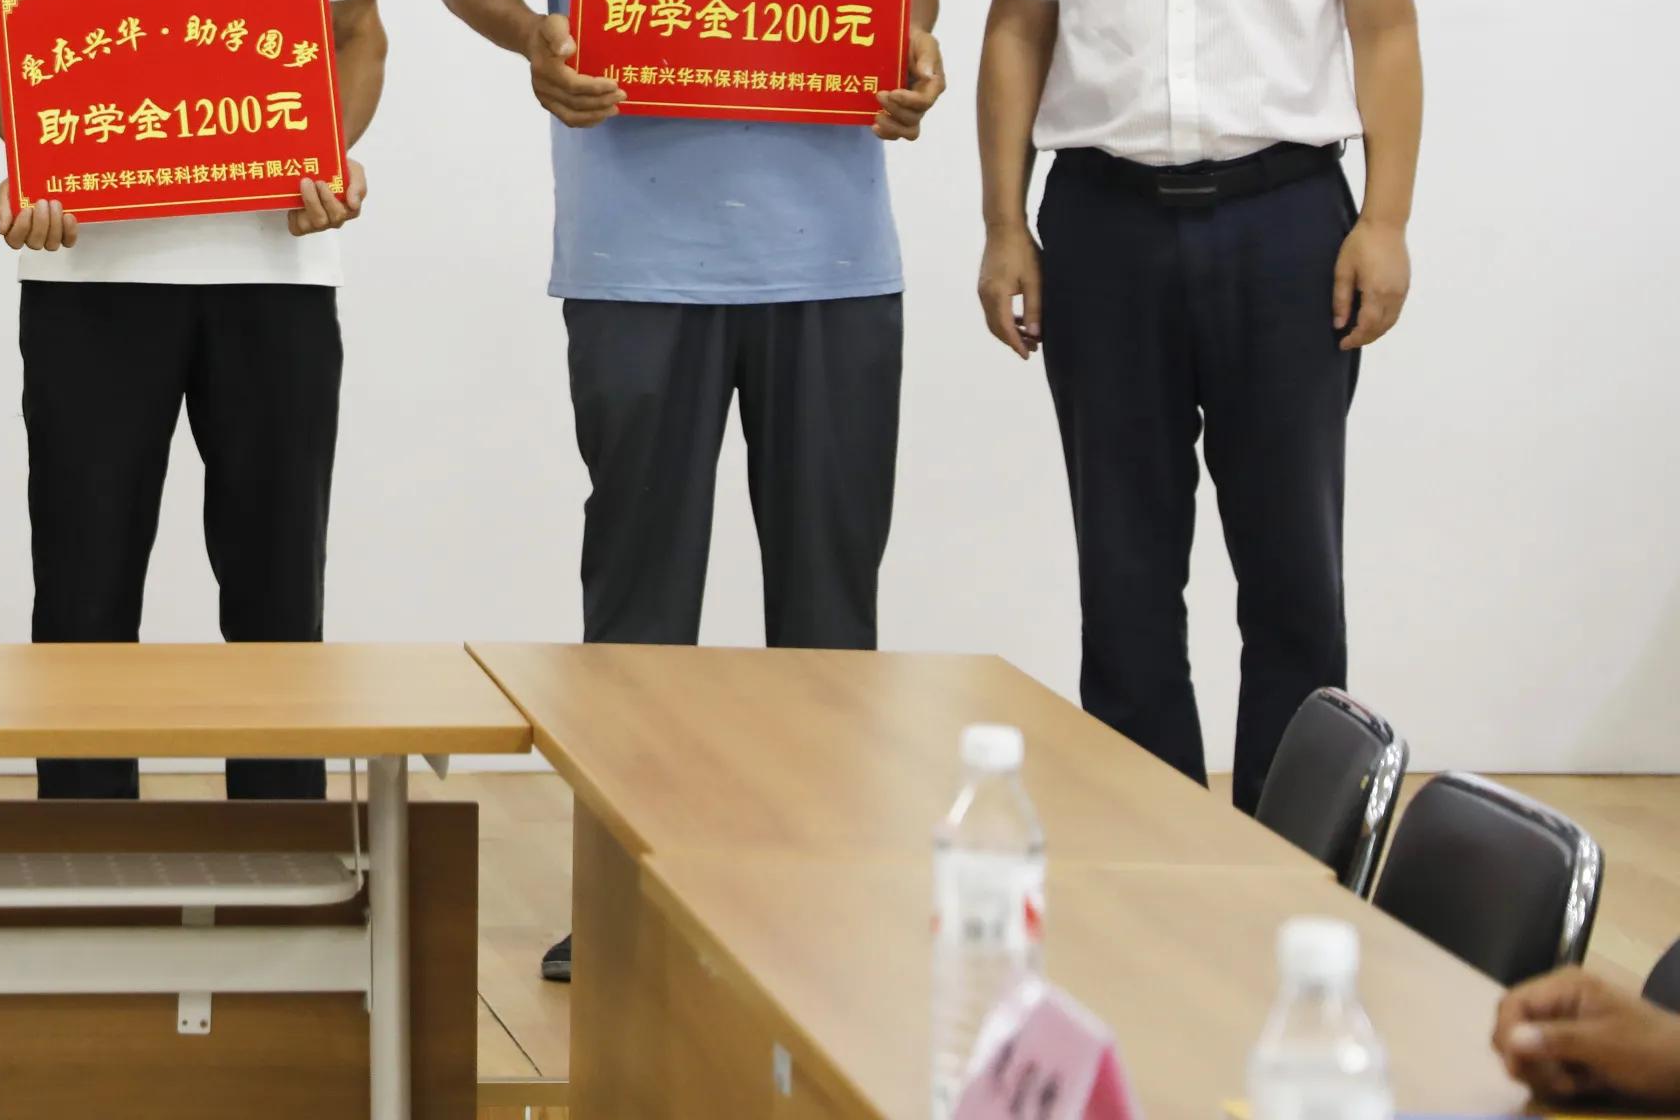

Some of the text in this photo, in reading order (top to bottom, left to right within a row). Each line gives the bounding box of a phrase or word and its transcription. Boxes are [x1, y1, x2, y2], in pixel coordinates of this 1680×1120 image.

[37, 91, 308, 145] 助学金1200元
[46, 157, 321, 193] 山东新兴华环保科技材料有限公司
